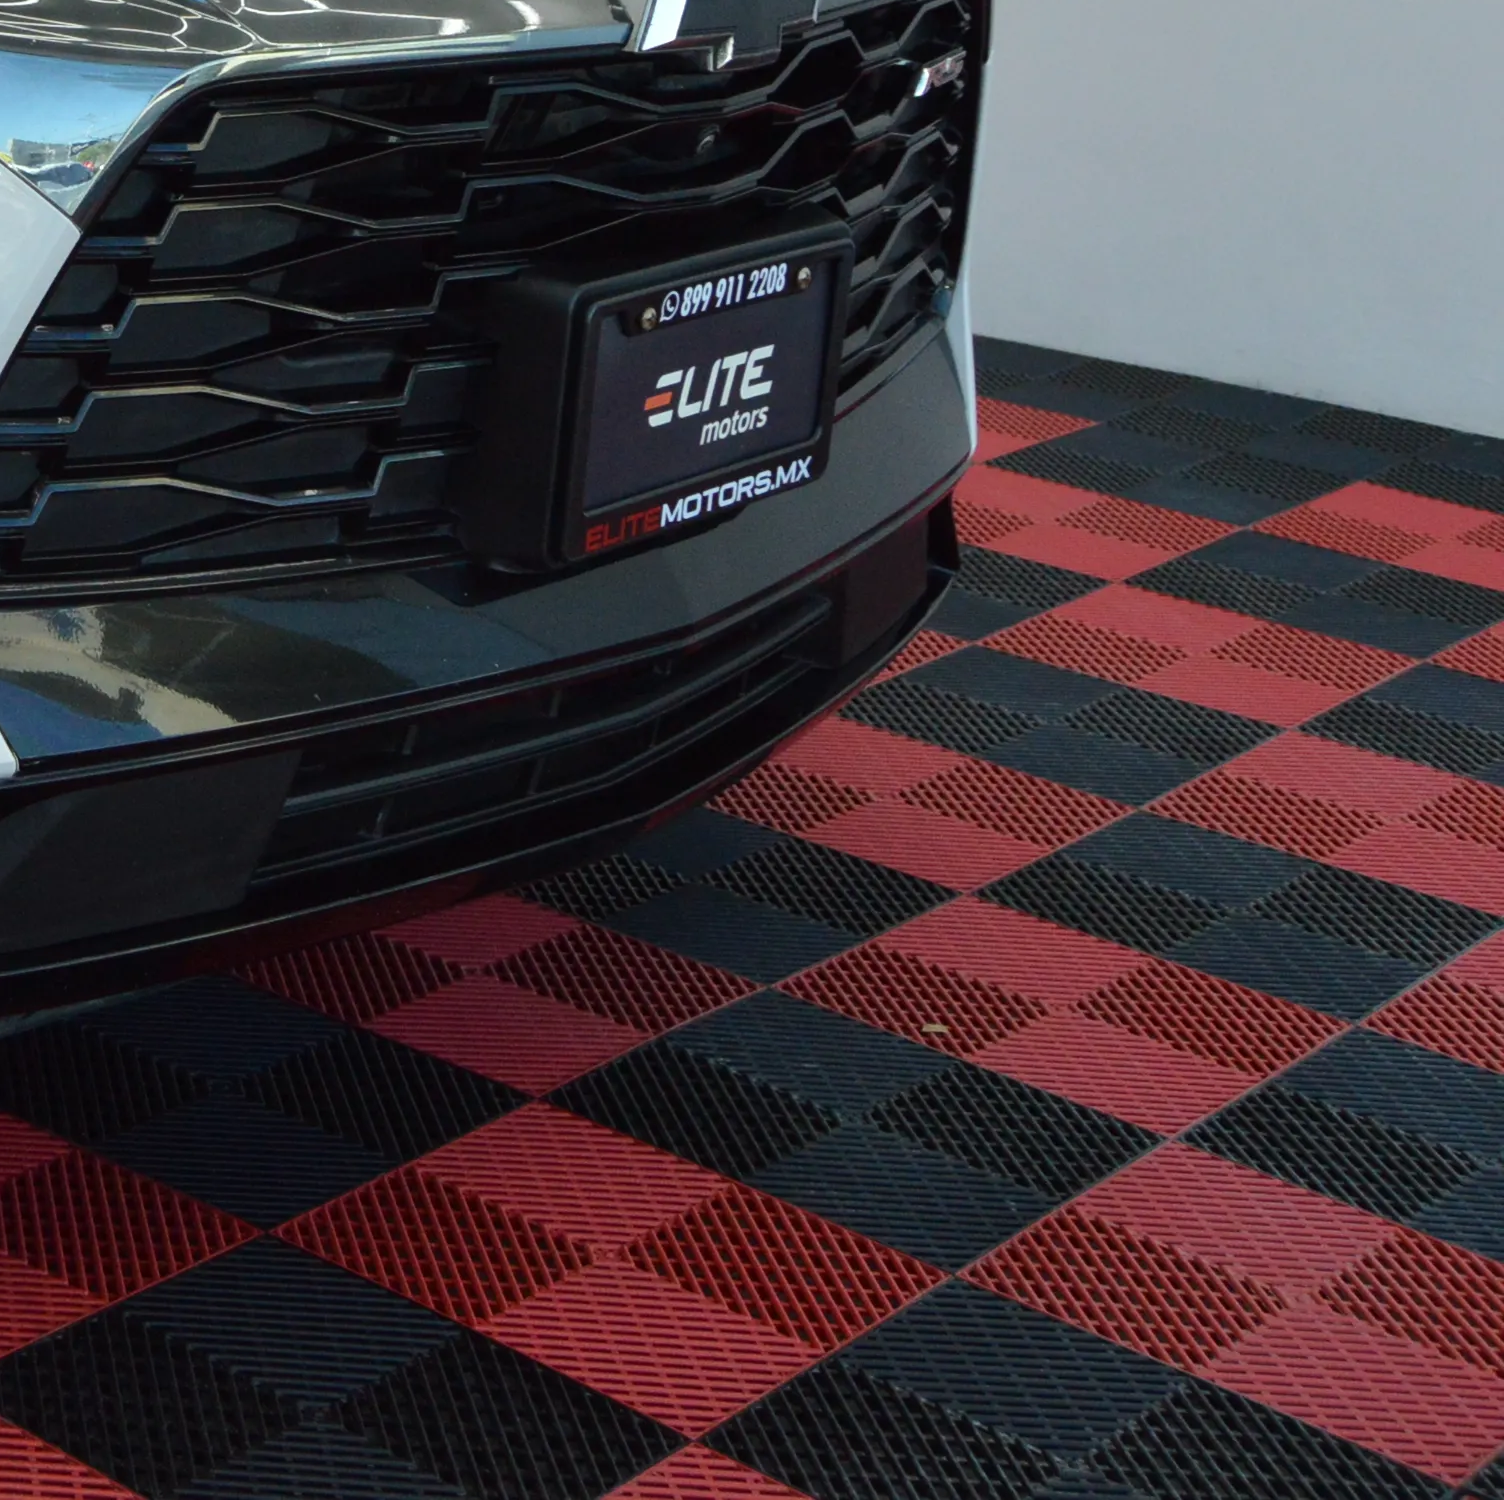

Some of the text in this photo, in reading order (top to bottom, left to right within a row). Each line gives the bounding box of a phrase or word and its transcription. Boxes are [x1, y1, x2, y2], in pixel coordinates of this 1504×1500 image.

[680, 262, 788, 317] 899 911 2208
[644, 344, 775, 428] ELITE
[700, 404, 769, 446] motors
[585, 455, 813, 552] ELITEMOTORS.MX
